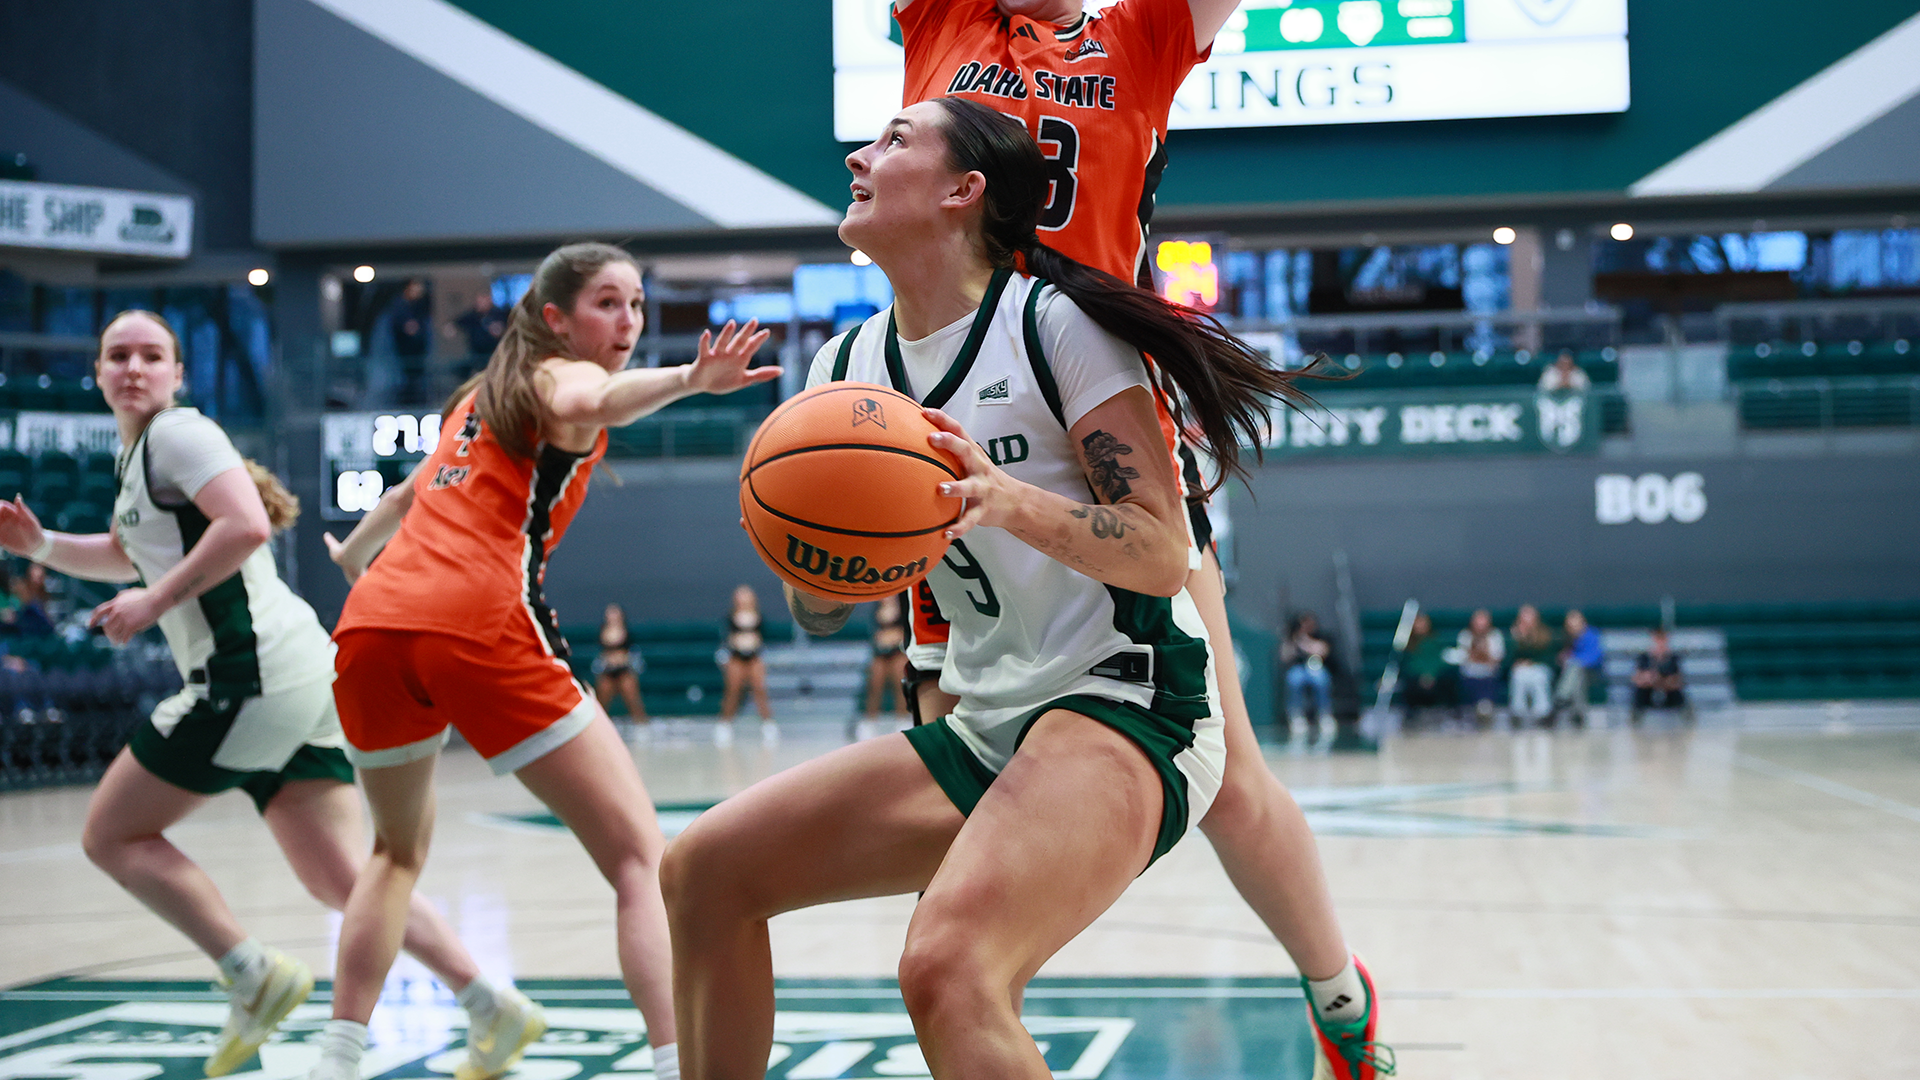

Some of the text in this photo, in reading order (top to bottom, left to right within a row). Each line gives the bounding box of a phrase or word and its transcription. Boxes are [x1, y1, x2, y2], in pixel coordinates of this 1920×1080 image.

[946, 62, 1115, 110] IDAHO STATE
[1174, 62, 1396, 113] INGS
[1400, 403, 1524, 444] DECK
[787, 533, 928, 584] Wilson
